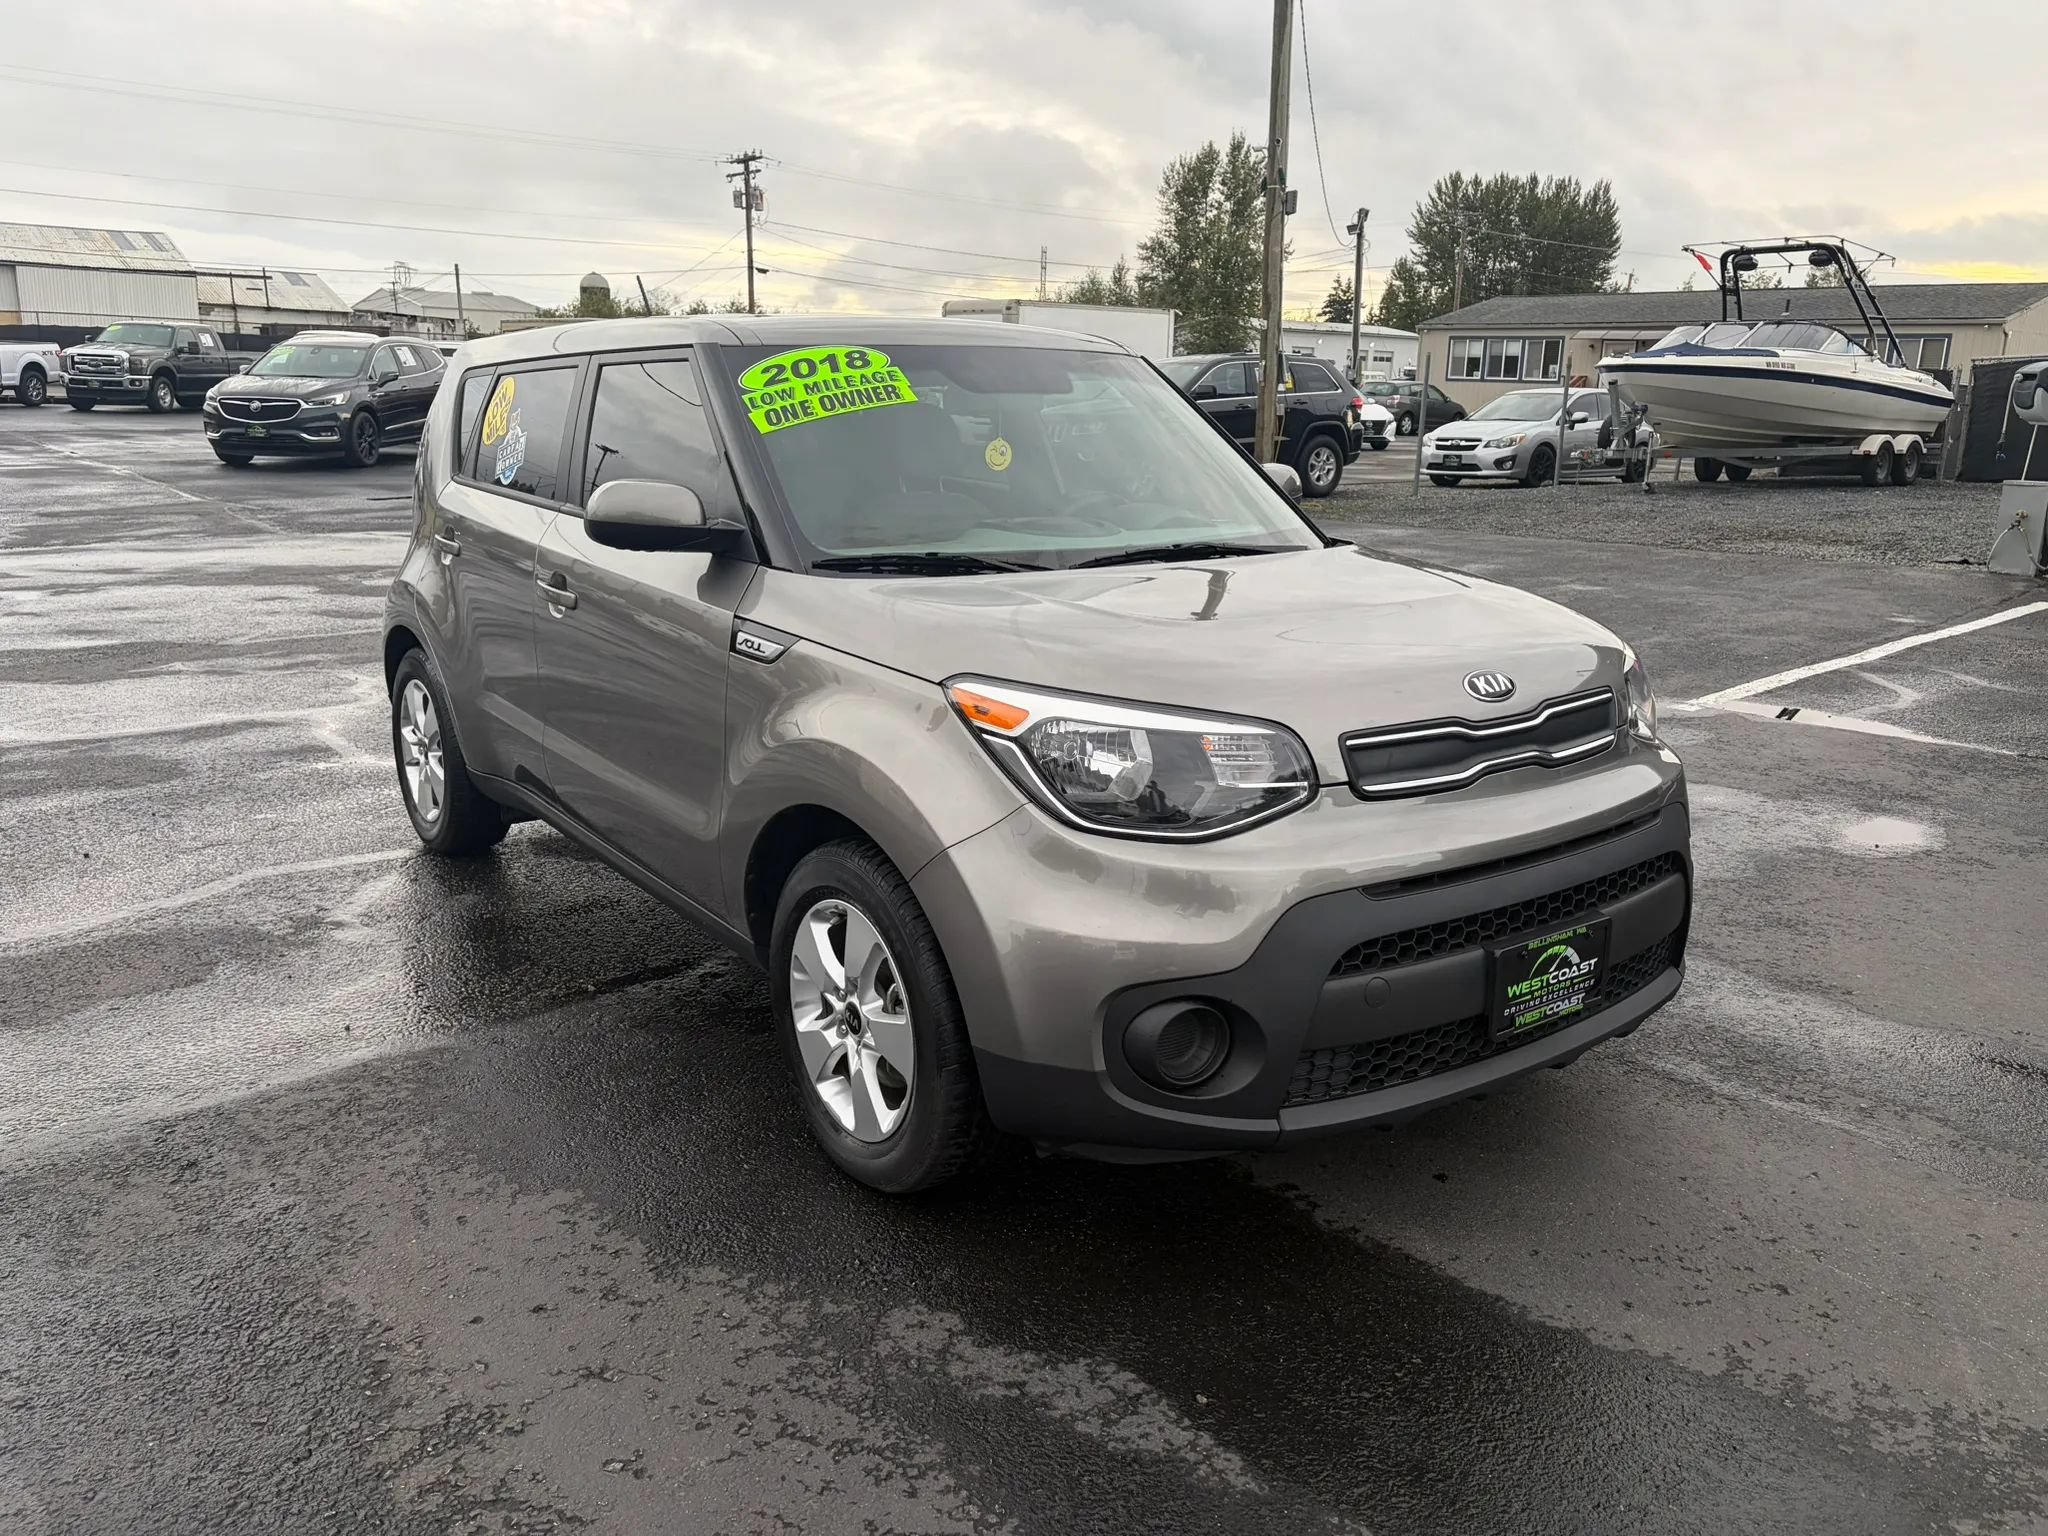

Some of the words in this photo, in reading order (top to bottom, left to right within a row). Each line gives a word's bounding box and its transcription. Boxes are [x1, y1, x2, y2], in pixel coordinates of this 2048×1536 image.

[760, 350, 873, 388] 2018
[749, 387, 795, 410] LOW
[802, 370, 903, 396] MILEAGE
[764, 399, 818, 427] ONE
[818, 385, 904, 413] OWNER
[1471, 673, 1513, 695] KIA
[1503, 997, 1540, 1016] DRIVING
[1542, 978, 1595, 1002] EXCELLENCE
[1533, 979, 1571, 998] MOTORS
